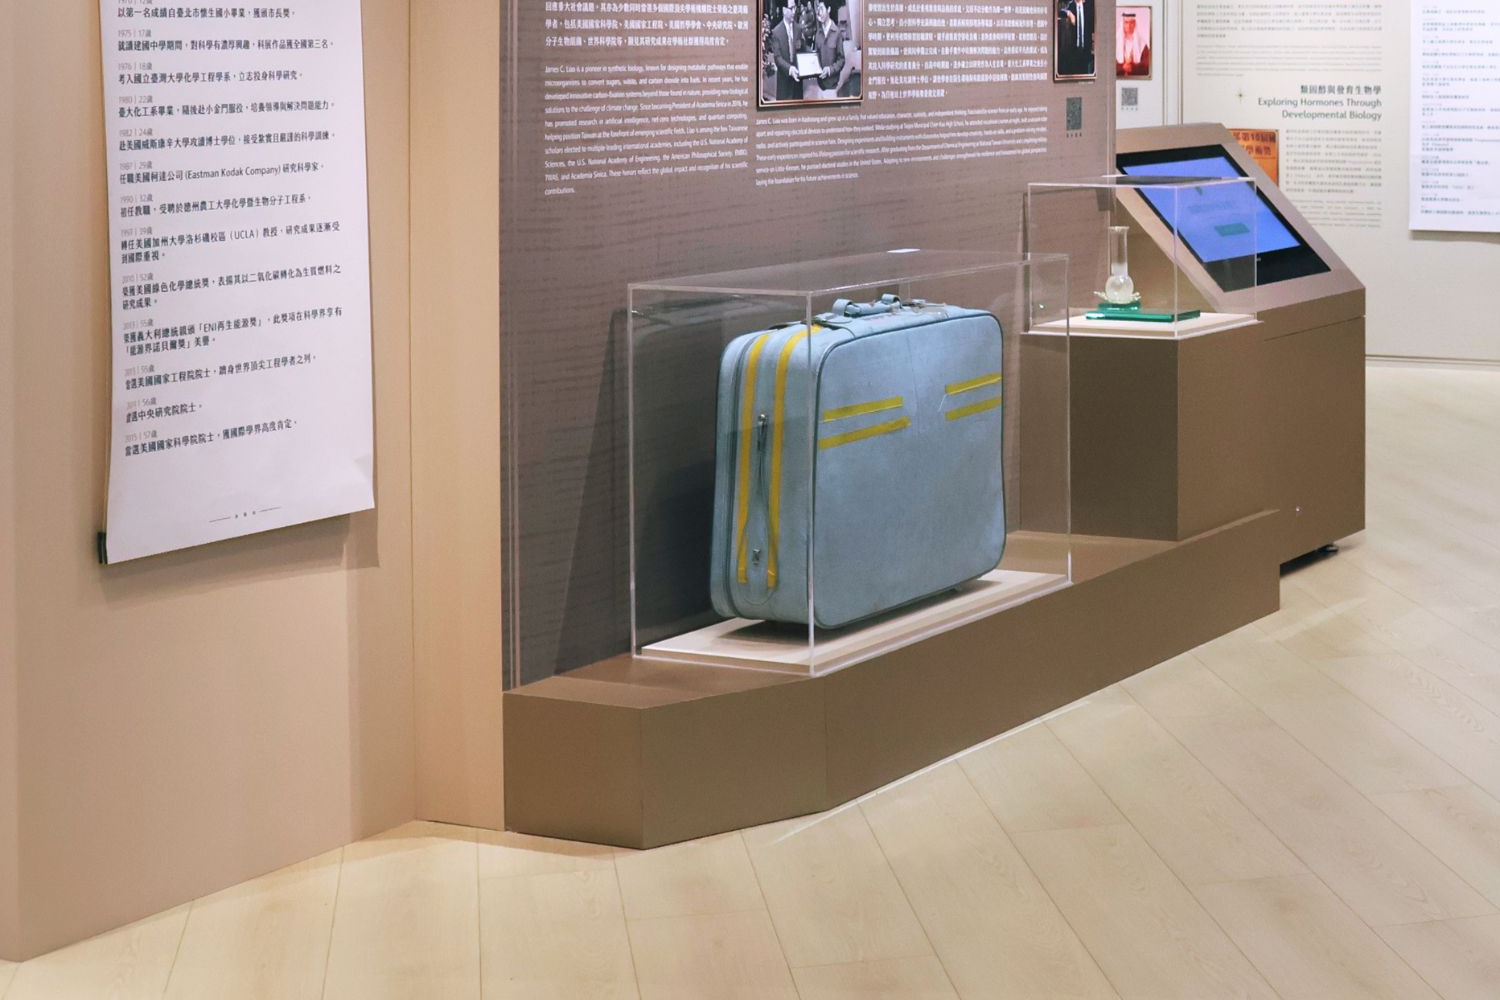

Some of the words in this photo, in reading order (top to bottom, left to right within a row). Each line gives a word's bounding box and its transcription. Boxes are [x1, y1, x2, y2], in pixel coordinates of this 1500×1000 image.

[1258, 98, 1298, 107] Exploring
[1300, 98, 1344, 107] Hormones
[1346, 98, 1382, 108] Through
[1282, 110, 1347, 121] Developmental
[1349, 111, 1382, 122] Biology
[185, 170, 219, 181] (Eastman
[221, 168, 243, 177] Kodak
[245, 166, 281, 177] Company)
